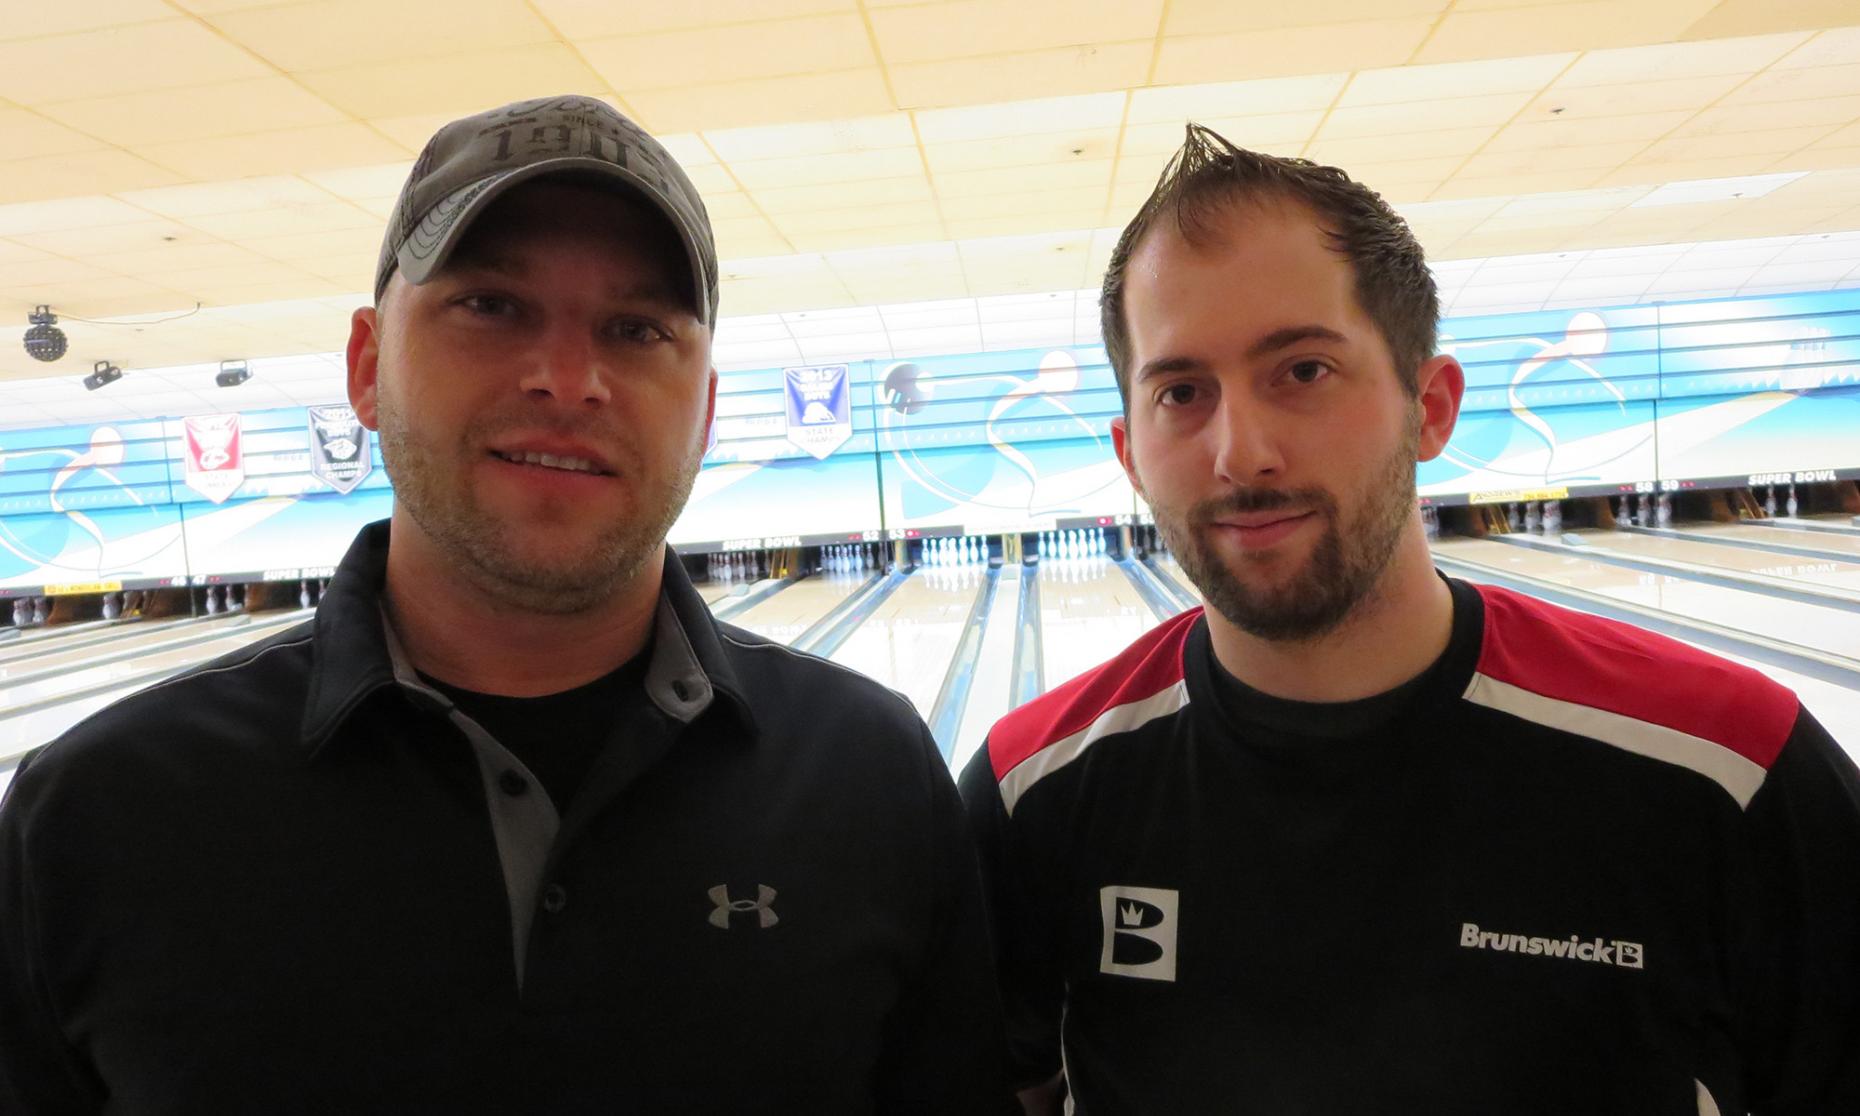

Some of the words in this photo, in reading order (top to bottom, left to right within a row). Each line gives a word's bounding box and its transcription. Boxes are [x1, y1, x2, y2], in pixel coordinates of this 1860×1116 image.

[562, 114, 605, 129] SINCE
[320, 461, 365, 472] REGIONAL
[325, 470, 363, 481] CHAMPS
[1748, 472, 1792, 484] SUPER
[1795, 469, 1837, 481] BOWL
[1635, 481, 1653, 493] 58
[1661, 479, 1679, 491] 59
[1114, 513, 1133, 526] 54
[862, 529, 880, 542] 52
[888, 528, 905, 541] 53
[722, 539, 761, 551] SUPER
[764, 536, 802, 548] BOWL
[191, 574, 207, 586] 47
[263, 569, 299, 581] SUPER
[1107, 892, 1168, 970] B
[1459, 922, 1616, 964] Brunswick
